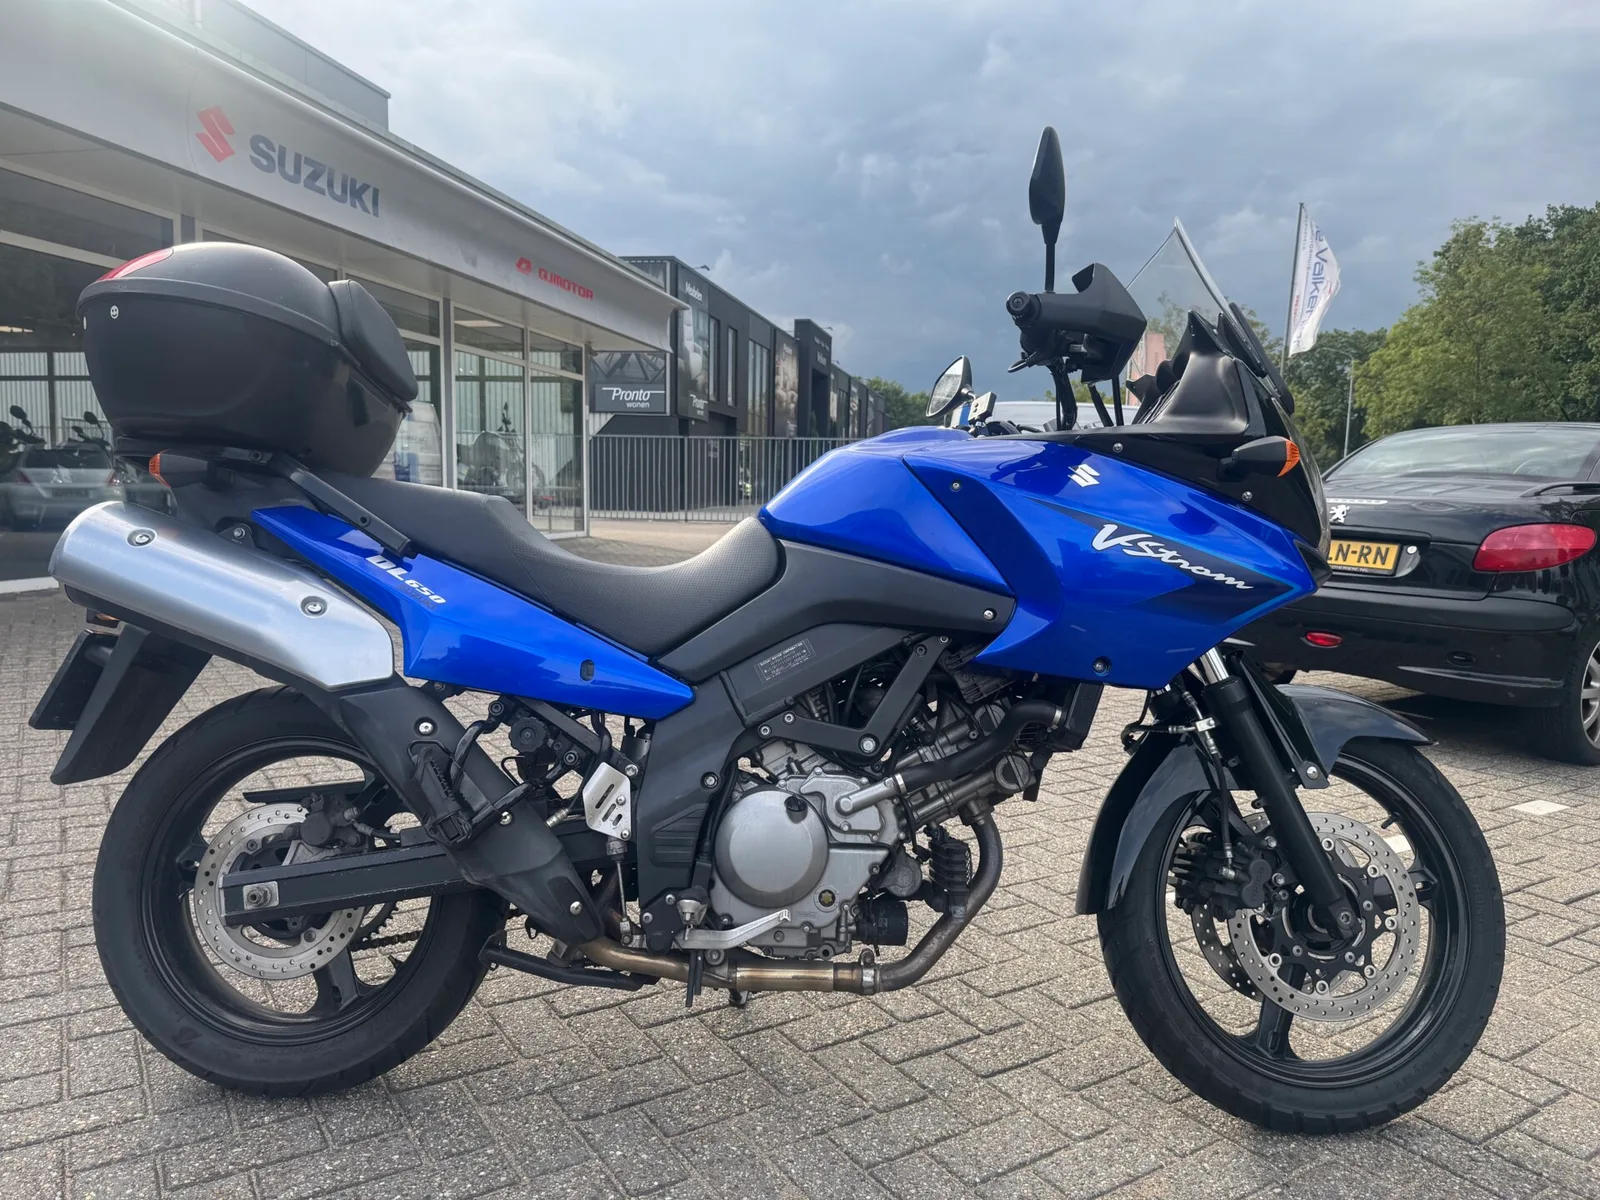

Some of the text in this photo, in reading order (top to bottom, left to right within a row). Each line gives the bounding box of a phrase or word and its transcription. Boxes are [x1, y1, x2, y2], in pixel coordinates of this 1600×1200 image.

[249, 133, 380, 218] SUZUKI
[608, 388, 656, 401] Pronto
[626, 401, 650, 409] wonen
